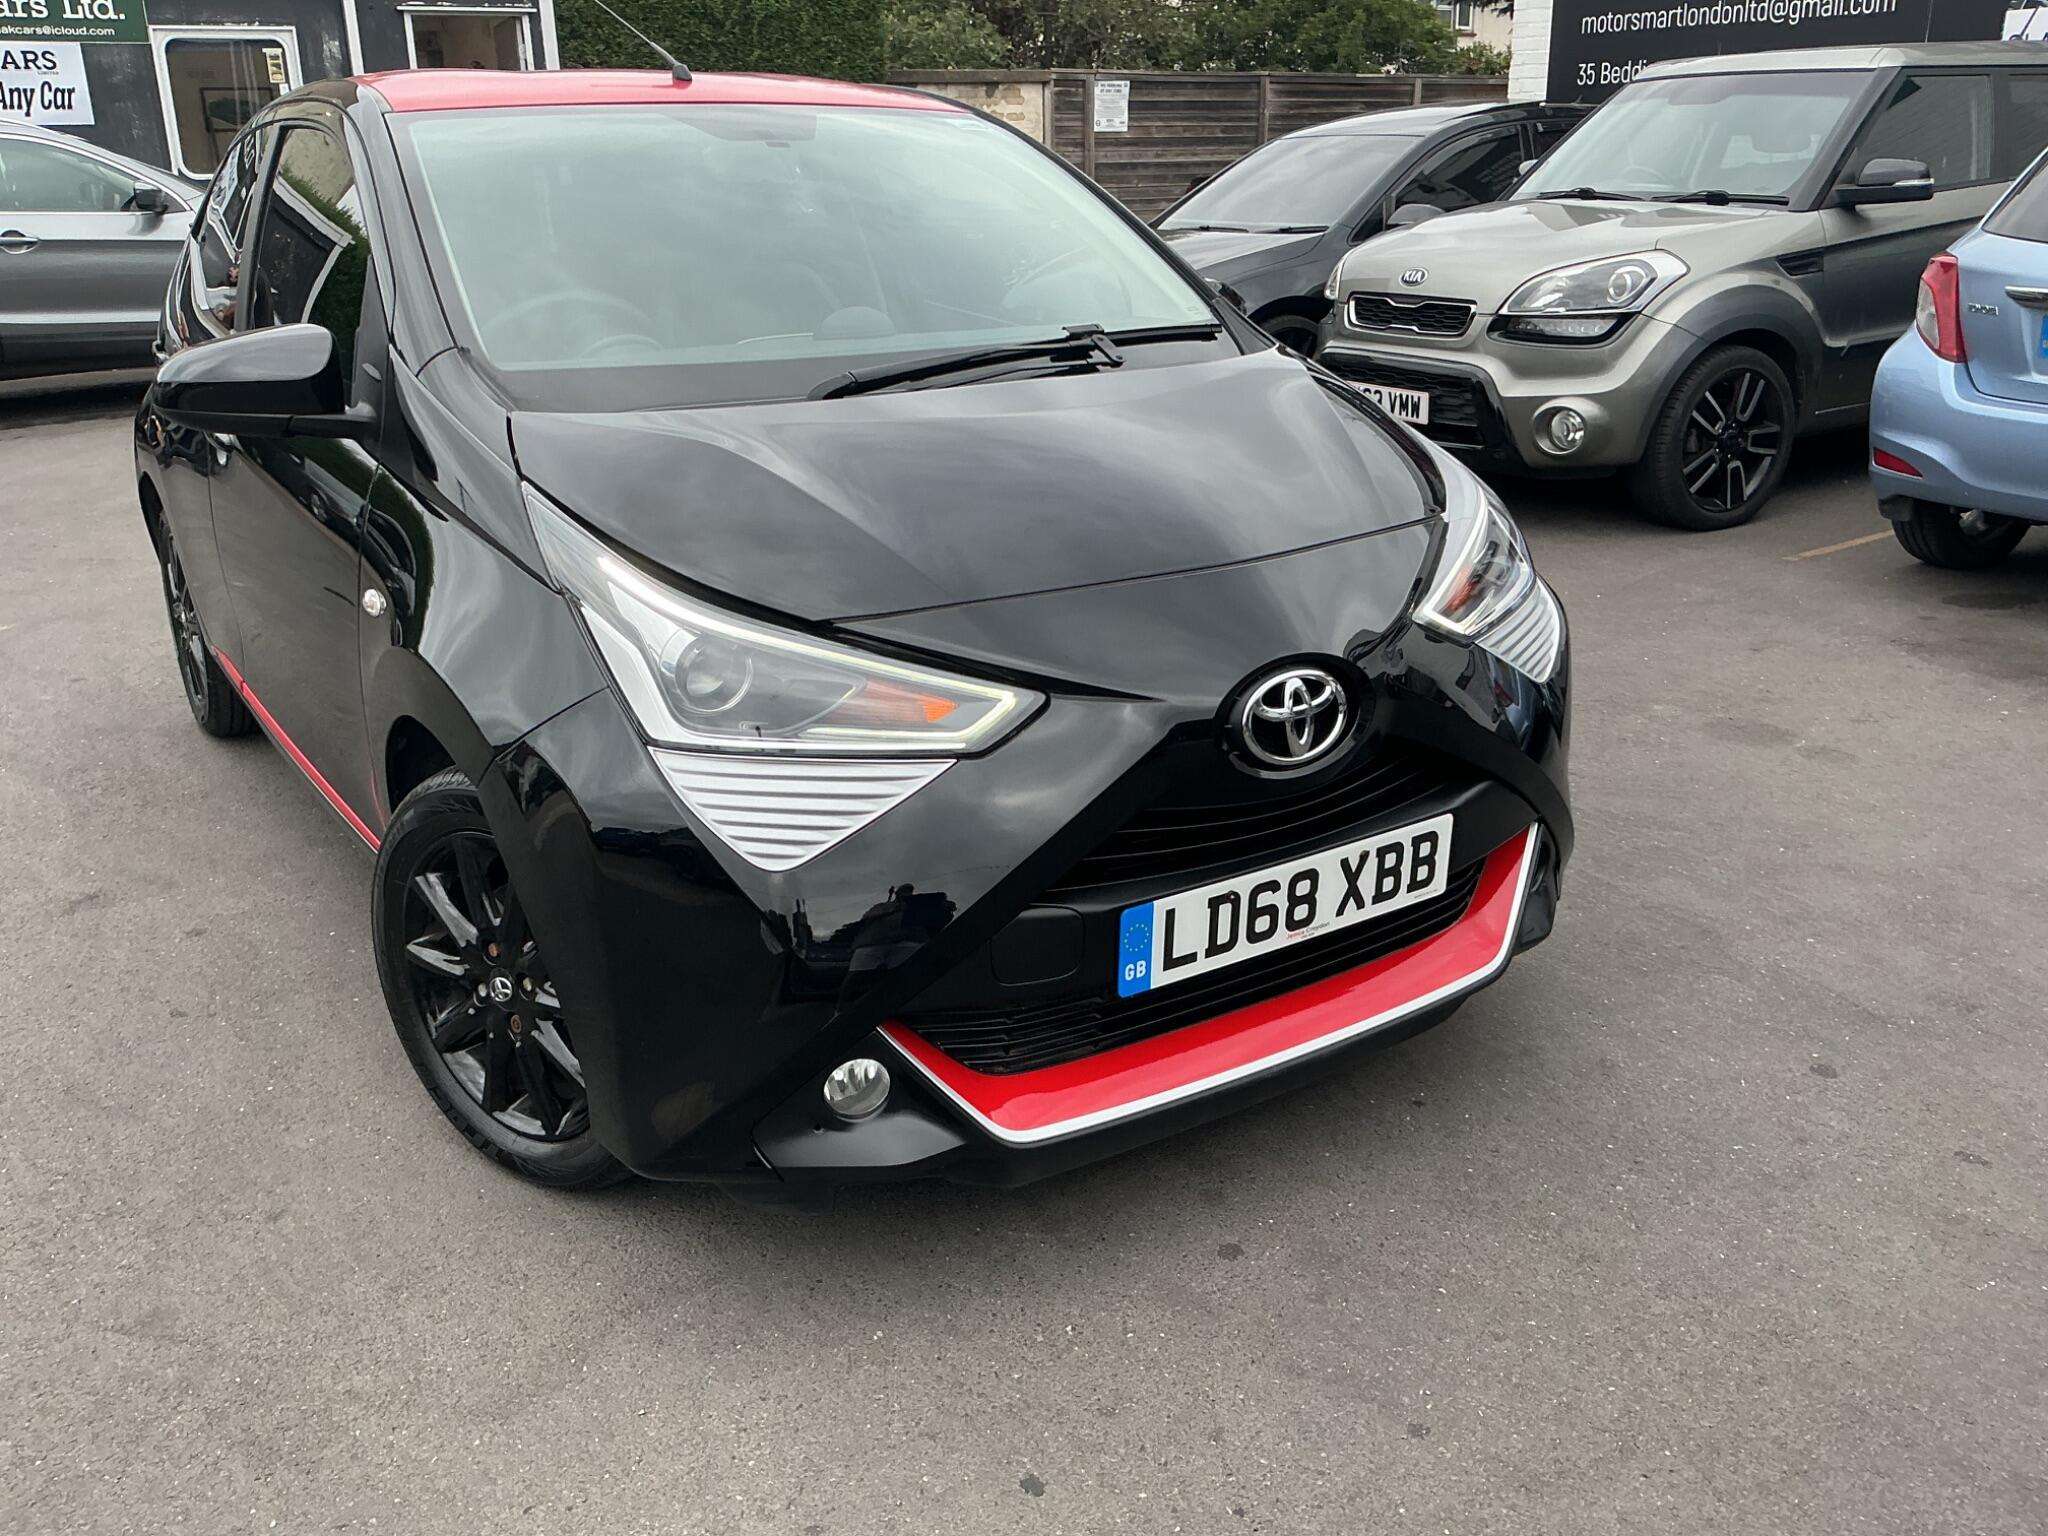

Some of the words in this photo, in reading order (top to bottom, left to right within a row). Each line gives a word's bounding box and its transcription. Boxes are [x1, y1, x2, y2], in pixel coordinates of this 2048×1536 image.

[62, 0, 126, 20] Ltd.
[1581, 0, 1897, 34] motorsmartlondonltd@gmail.com
[0, 25, 115, 36] akcars@icloud.com
[1, 50, 58, 70] ARS
[1577, 63, 1595, 86] 35
[40, 80, 76, 110] Car
[1388, 391, 1421, 419] VMW
[1162, 867, 1320, 972] LD68
[1335, 830, 1439, 918] XBB
[1125, 960, 1147, 981] GB
